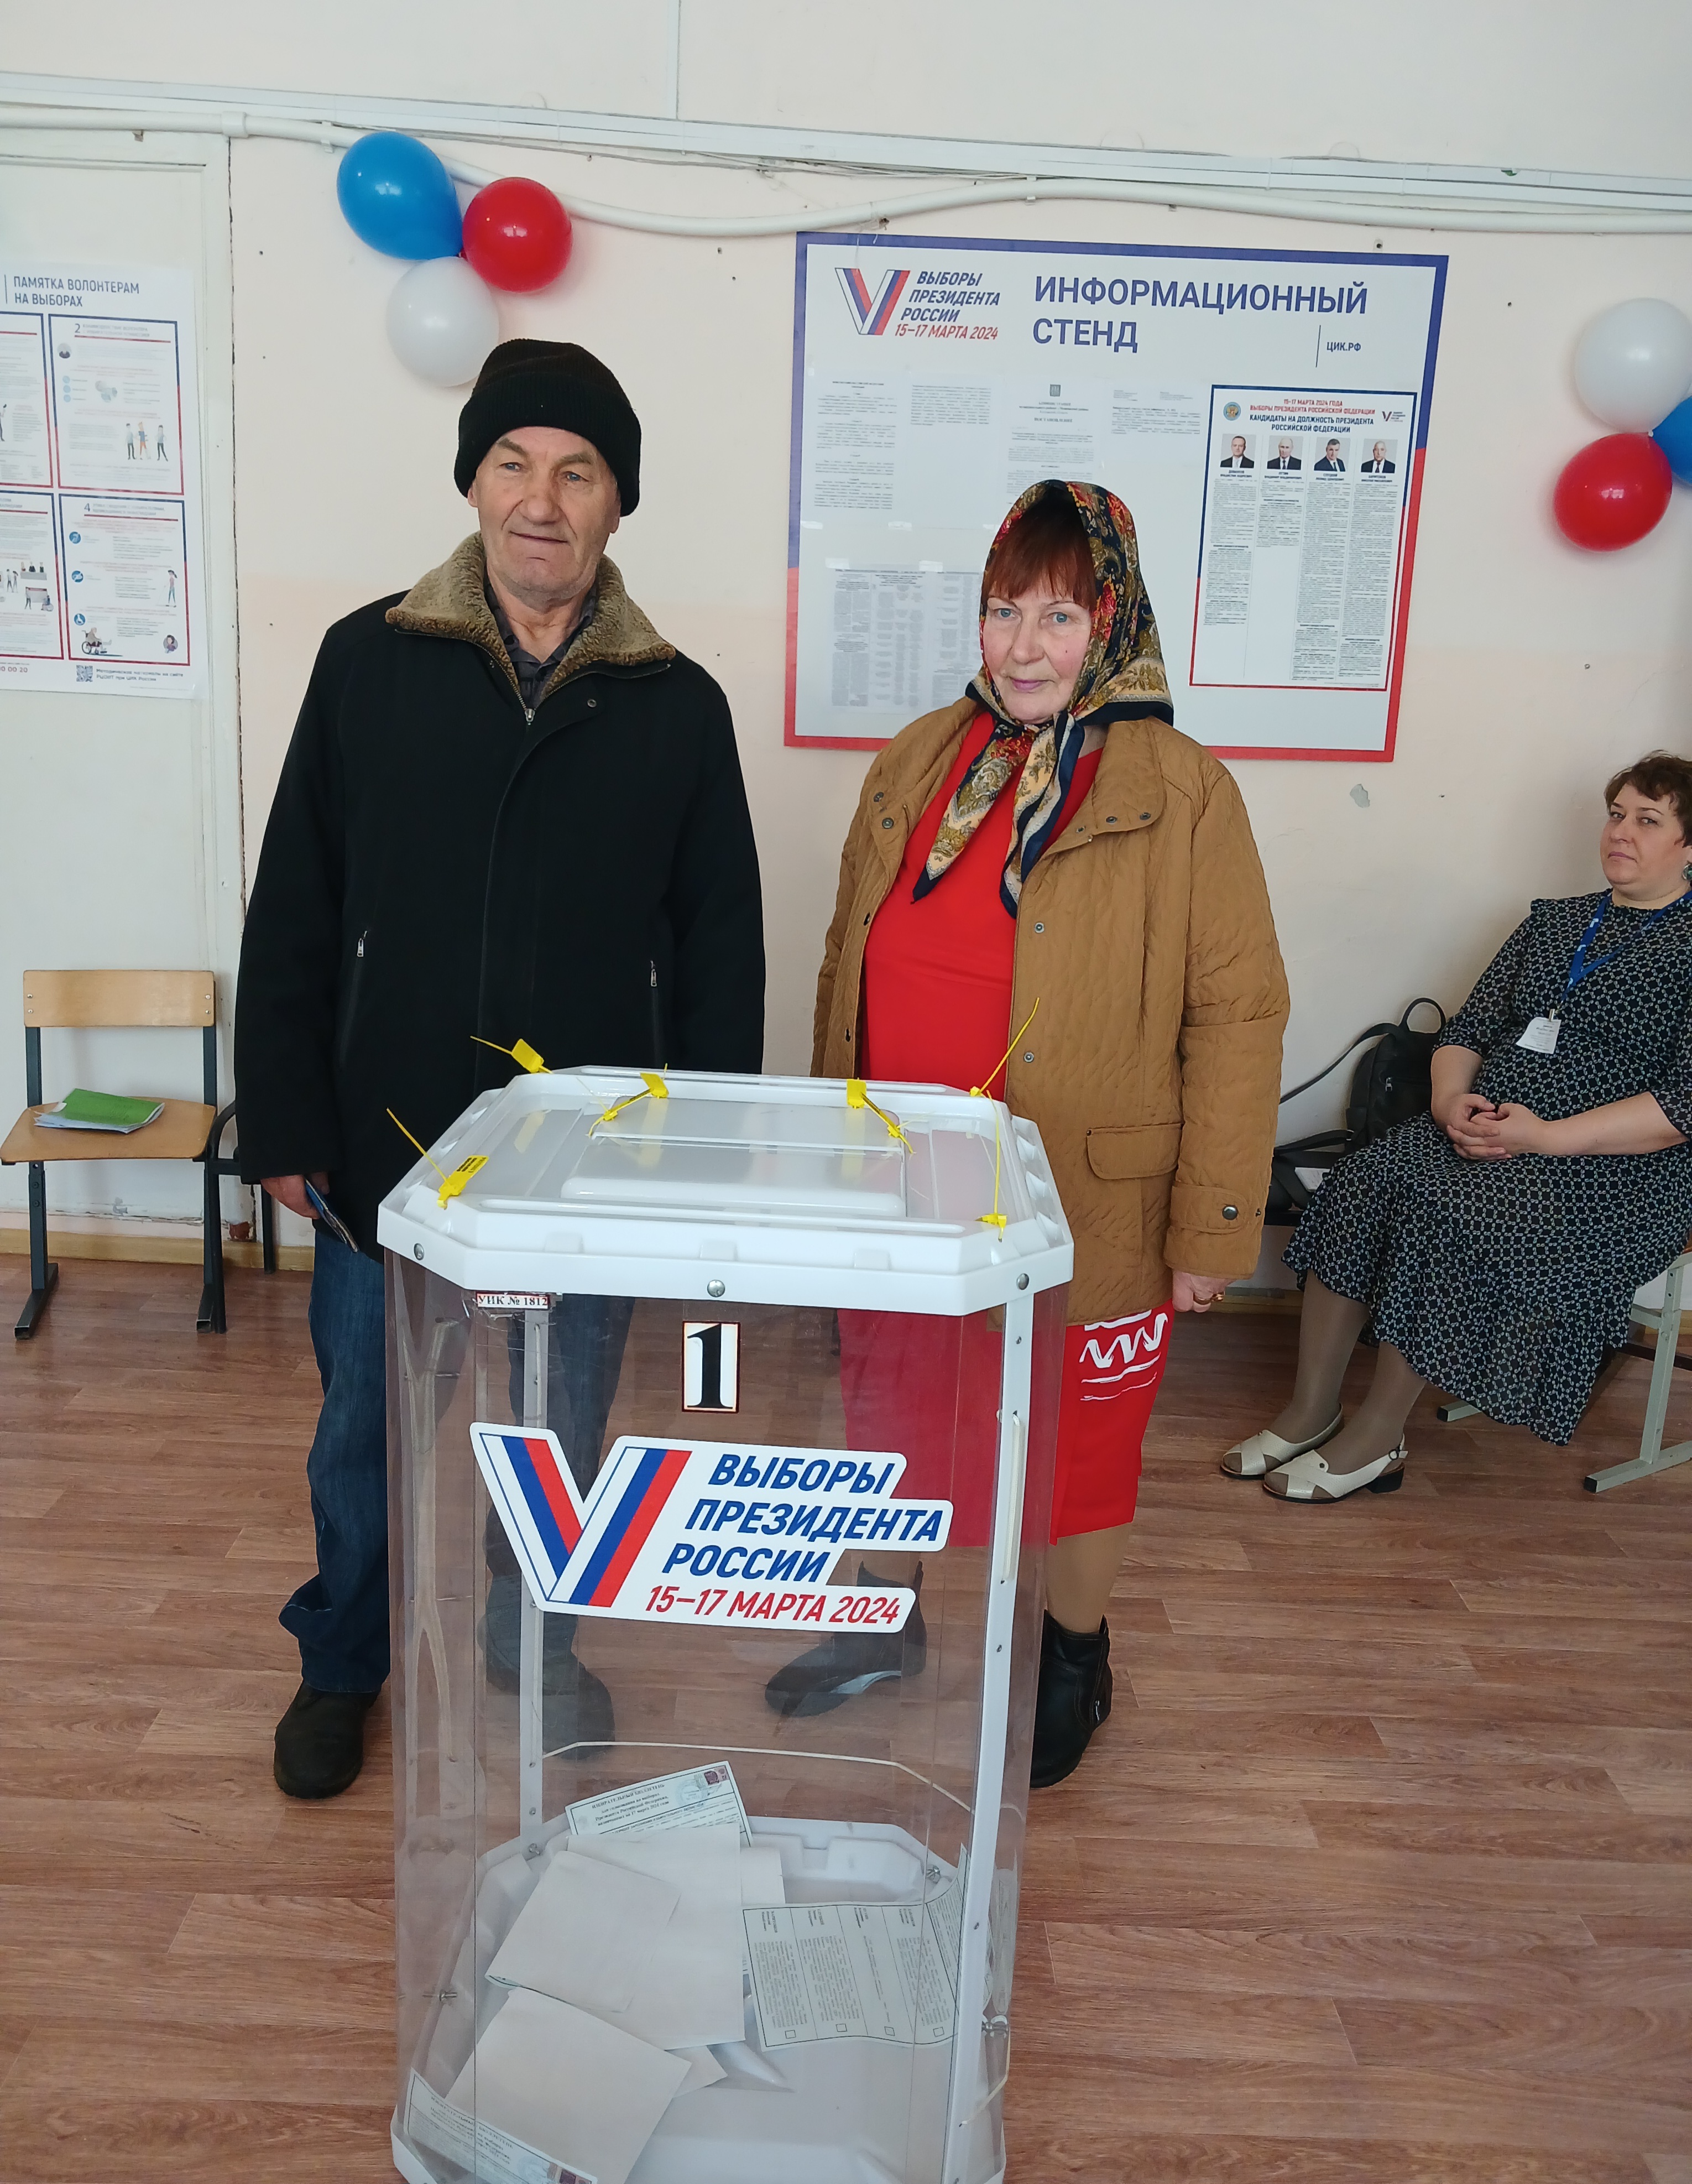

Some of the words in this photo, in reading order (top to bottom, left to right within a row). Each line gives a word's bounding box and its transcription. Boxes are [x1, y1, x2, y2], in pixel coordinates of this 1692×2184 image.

[14, 276, 64, 289] ПАМЯТКА
[67, 279, 139, 294] ВОЛОНТЕРАМ
[917, 271, 983, 286] ВЫБОРЫ
[15, 293, 28, 304] НА
[32, 294, 83, 307] ВЫБОРАХ
[909, 290, 1000, 306] ПРЕЗИДЕНТА
[1035, 276, 1367, 315] ИНФОРМАЦИОННЫЙ
[901, 307, 960, 322] РОССИИ
[75, 323, 81, 333] 2
[928, 325, 968, 338] МАРТА
[969, 327, 999, 340] 2024
[1033, 318, 1138, 353] СТЕНД
[1327, 342, 1361, 352] ЦИК.РФ
[1271, 423, 1312, 431] РОССИЙСКОЙ
[1335, 417, 1374, 425] ПРЕЗИДЕНТА
[478, 1295, 504, 1305] УИК
[524, 1297, 548, 1306] 1812
[687, 1323, 733, 1409] 1
[708, 1453, 895, 1494] ВЫБОРЫ
[685, 1499, 944, 1544] ПРЕЗИДЕНТА
[661, 1544, 831, 1583] РОССИИ
[730, 1589, 828, 1623] МАРТА
[829, 1596, 901, 1625] 2024
